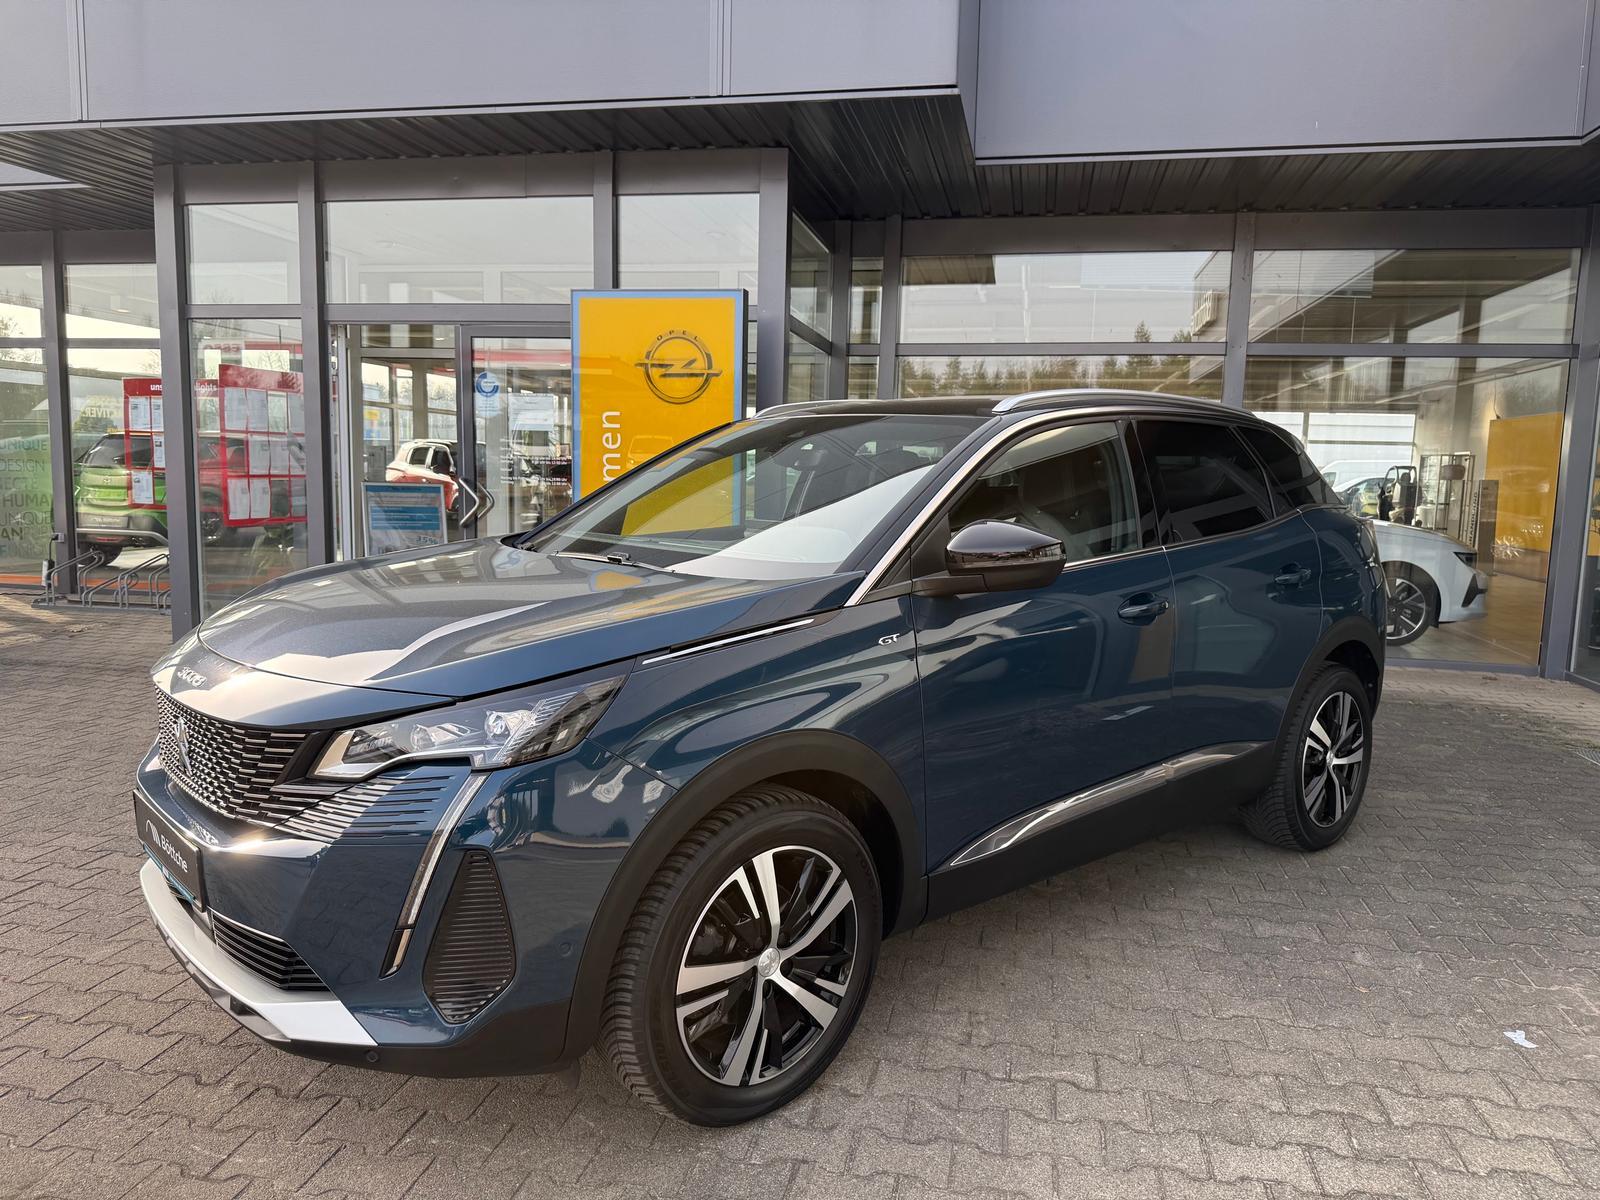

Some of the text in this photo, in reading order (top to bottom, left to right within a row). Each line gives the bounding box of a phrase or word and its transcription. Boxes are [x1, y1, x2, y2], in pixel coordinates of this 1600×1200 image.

[656, 329, 699, 342] OPEL
[602, 411, 621, 482] men
[879, 633, 900, 645] GT
[178, 666, 207, 688] 3008
